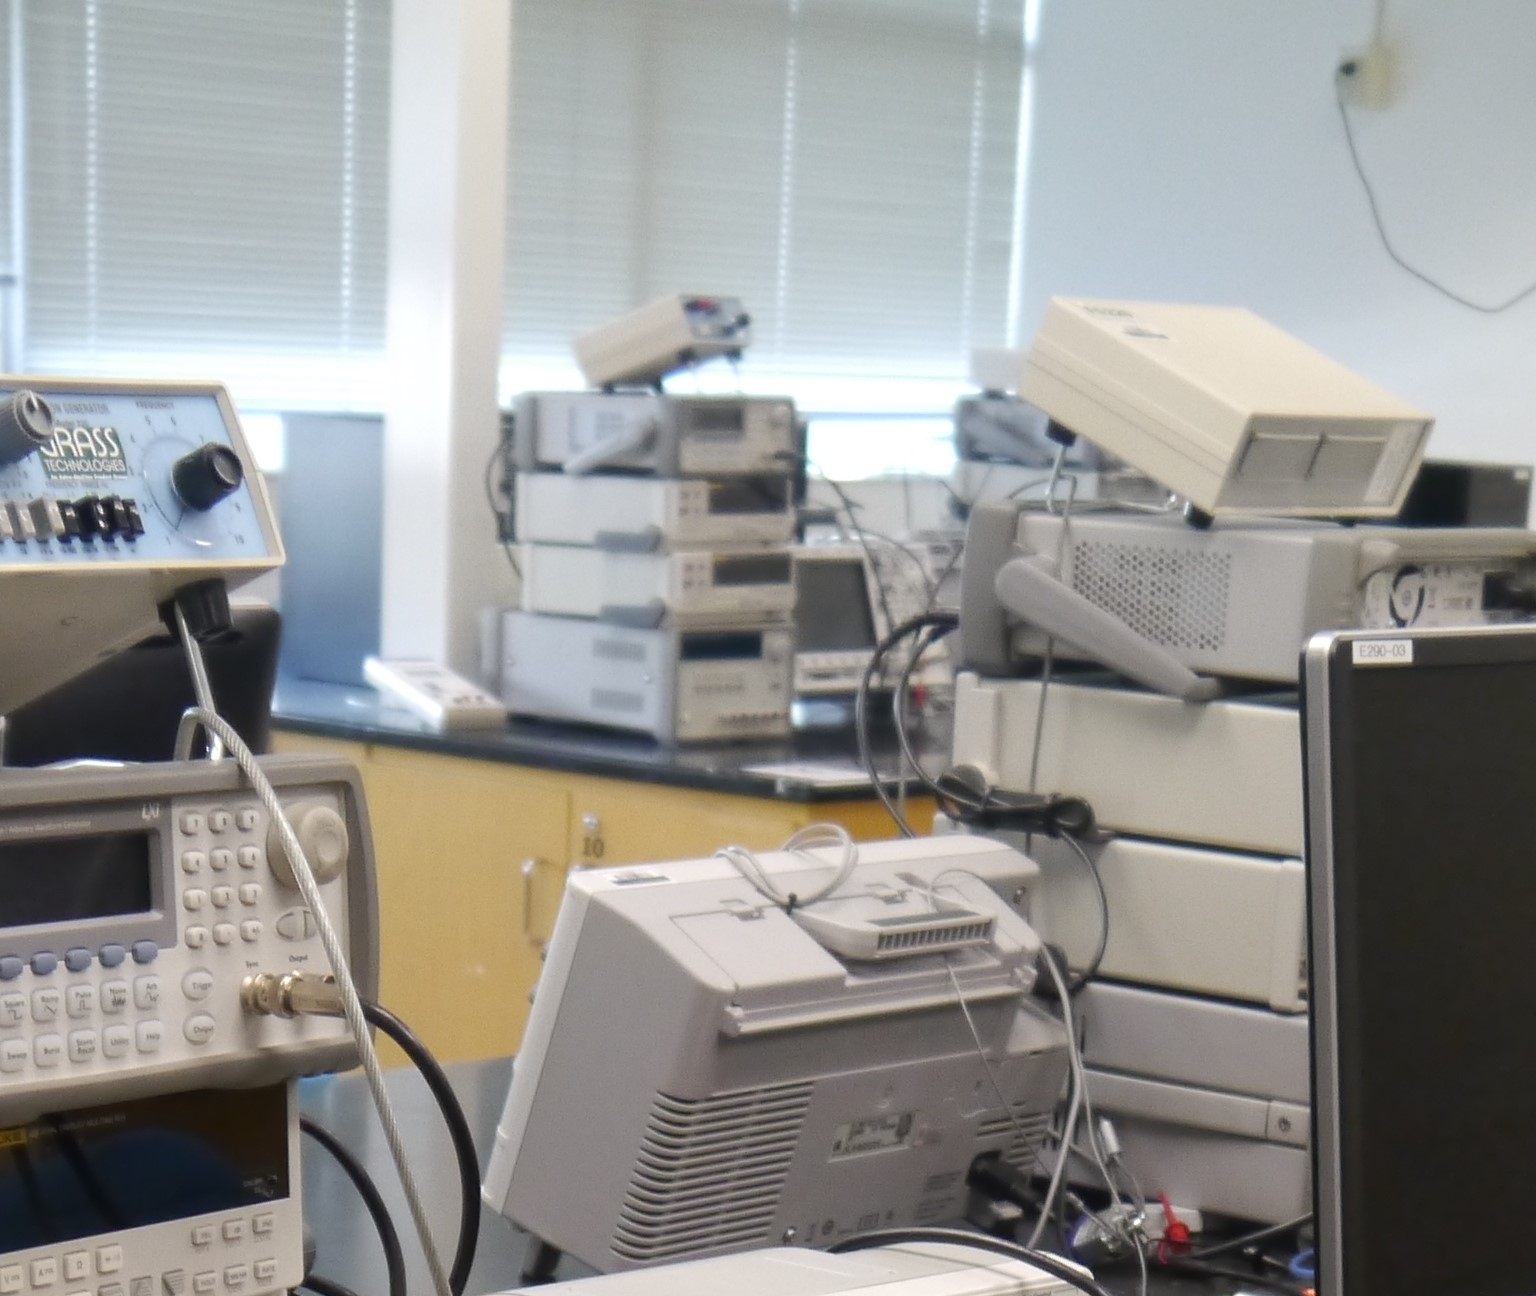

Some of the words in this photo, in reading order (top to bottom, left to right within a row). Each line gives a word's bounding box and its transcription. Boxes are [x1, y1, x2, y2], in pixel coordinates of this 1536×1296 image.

[44, 458, 127, 473] TECHNOLOGIES
[1359, 643, 1406, 658] E290-03
[288, 953, 309, 964] Output
[245, 960, 260, 969] Sync
[146, 1032, 161, 1042] Help
